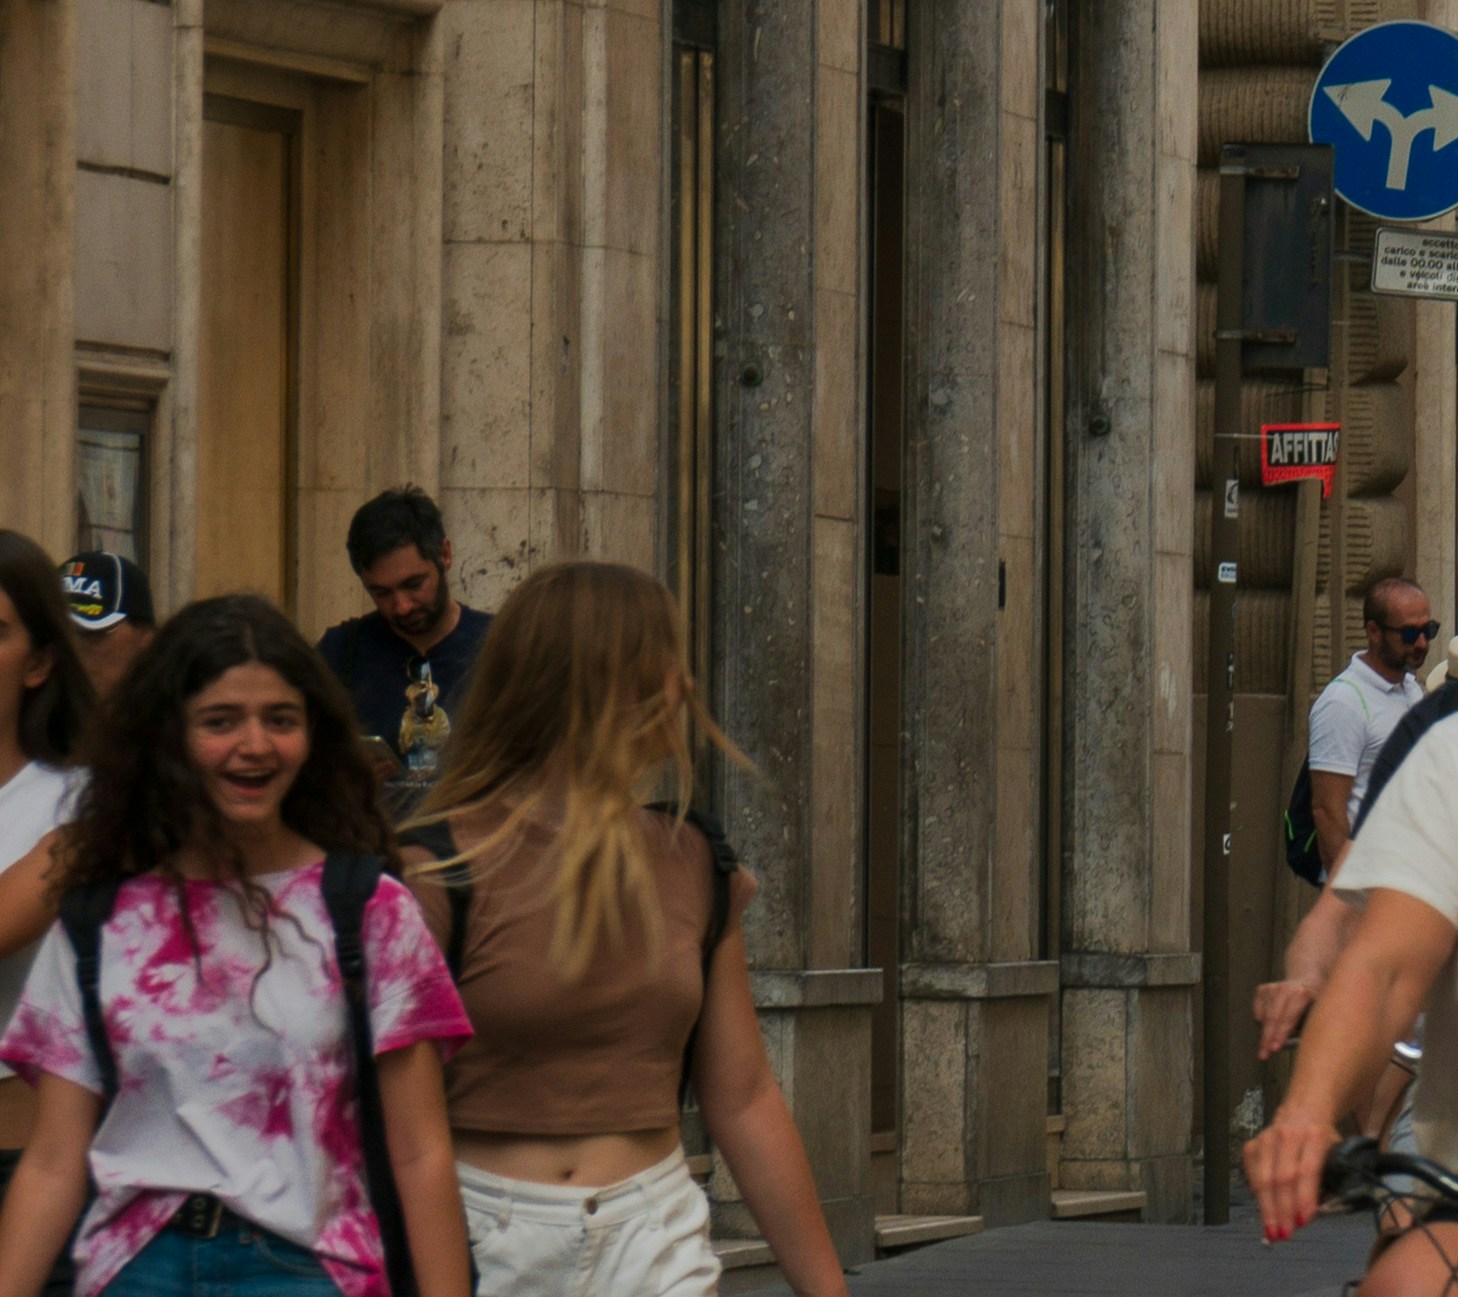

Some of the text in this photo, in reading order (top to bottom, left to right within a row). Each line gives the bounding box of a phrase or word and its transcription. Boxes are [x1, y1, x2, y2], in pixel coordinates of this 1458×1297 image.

[1384, 246, 1416, 257] carico
[1381, 256, 1407, 267] dalle
[1410, 258, 1443, 270] 00.00
[1410, 270, 1443, 281] veicoli
